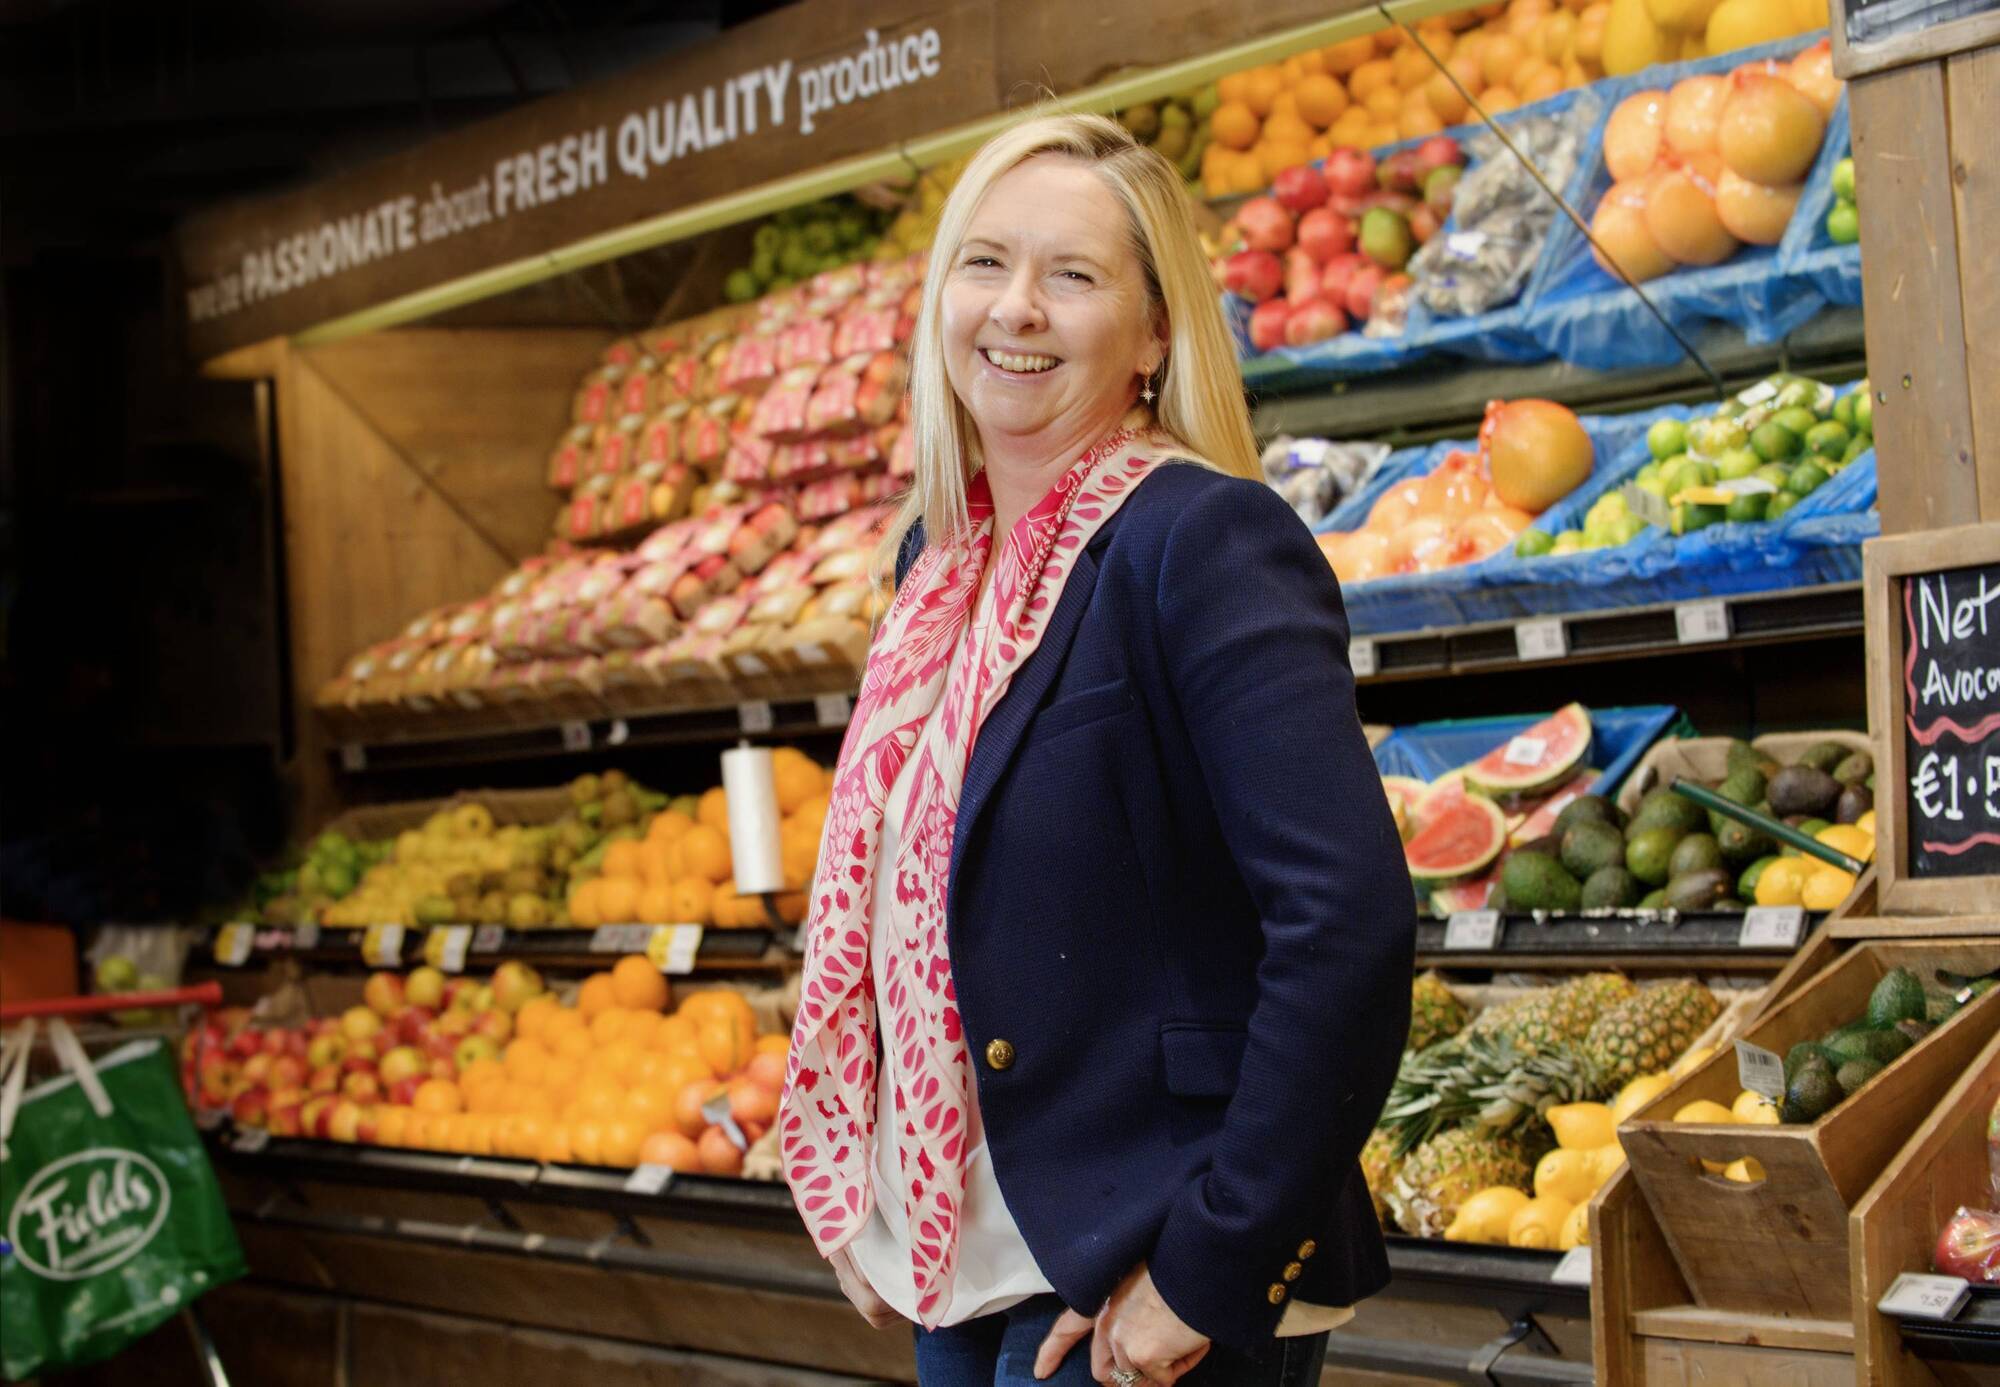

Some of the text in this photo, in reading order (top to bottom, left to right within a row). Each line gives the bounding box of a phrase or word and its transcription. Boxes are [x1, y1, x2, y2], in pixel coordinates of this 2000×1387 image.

[242, 196, 416, 304] PASSIONATE
[419, 181, 491, 242] about
[495, 126, 608, 218] FRESH
[617, 59, 792, 179] QUALITY
[798, 28, 940, 135] produce
[21, 1159, 152, 1268] Fields
